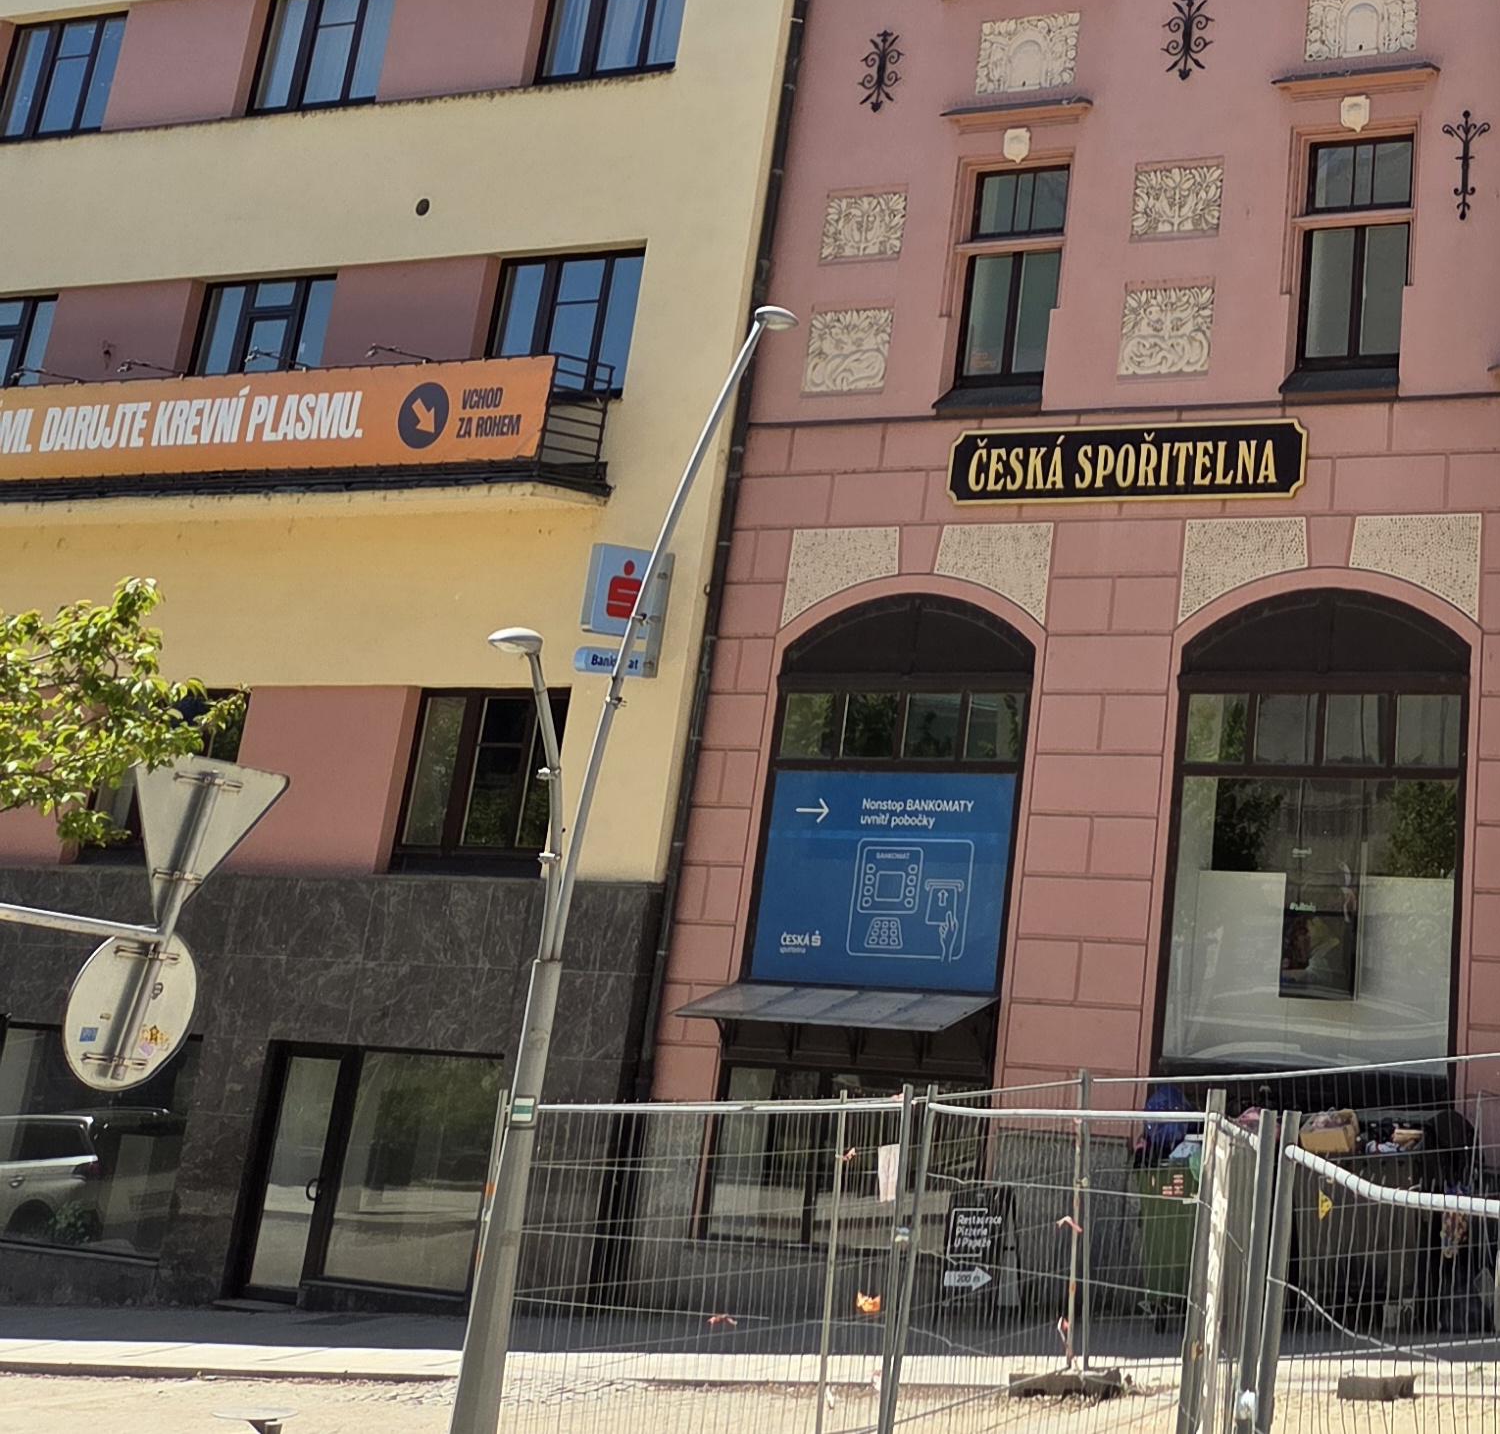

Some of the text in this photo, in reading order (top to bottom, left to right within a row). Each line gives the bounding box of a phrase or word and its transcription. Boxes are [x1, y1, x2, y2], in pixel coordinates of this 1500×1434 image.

[462, 387, 504, 410] VCHOD
[0, 385, 364, 454] MI. DARUJTE KREVNÍ PLASMU.
[456, 414, 522, 439] ZA ROHEM
[968, 432, 1278, 492] ČESKÁ SPOŘITELNA
[591, 653, 639, 671] Bankat
[862, 798, 975, 813] Nonstop BANKOMATY
[860, 813, 935, 829] uvnitř pobočky
[780, 931, 810, 946] ČESKÁ
